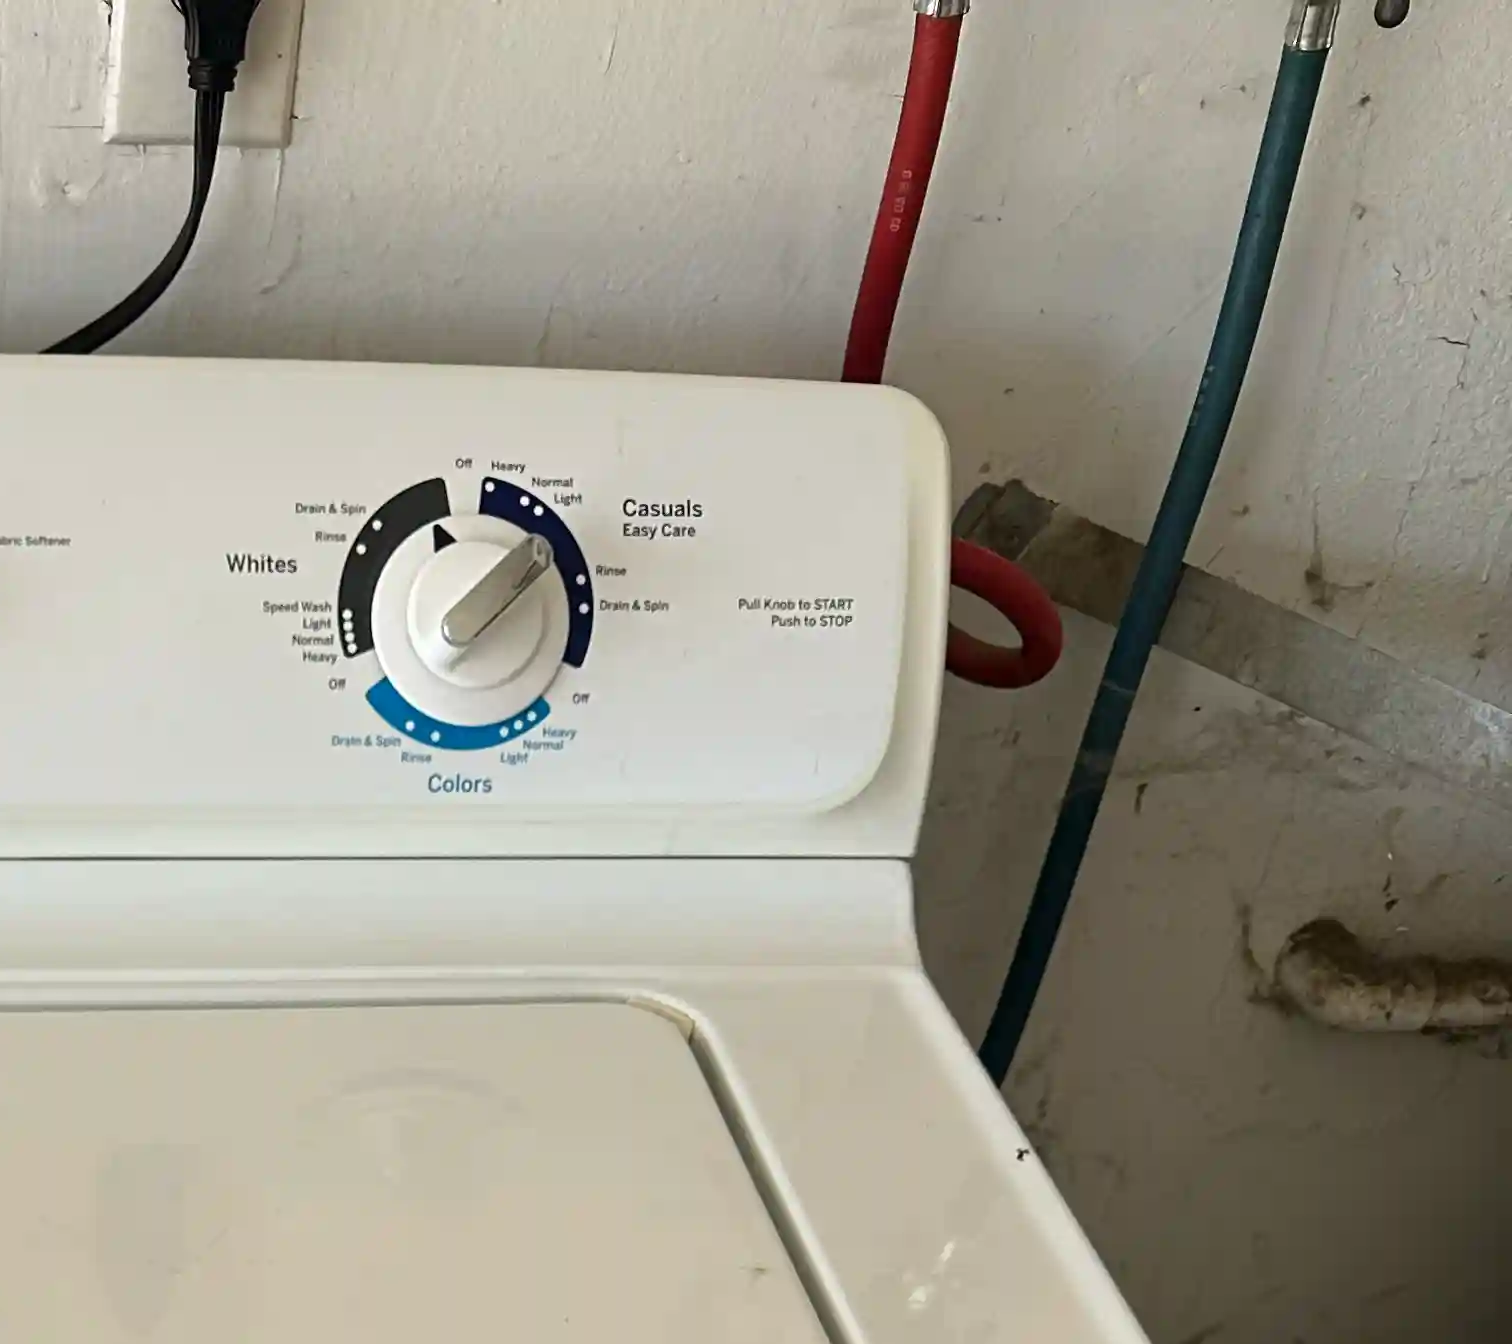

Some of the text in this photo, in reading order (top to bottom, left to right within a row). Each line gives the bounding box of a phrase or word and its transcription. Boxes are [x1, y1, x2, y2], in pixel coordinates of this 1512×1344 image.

[456, 458, 472, 469] Off
[491, 461, 525, 474] Heavy
[532, 477, 573, 487] Normal
[553, 494, 582, 506] Light
[296, 503, 325, 514] Drain
[340, 503, 366, 516] Spin
[623, 500, 702, 517] Casuals
[315, 531, 346, 542] Rinse
[622, 523, 696, 540] Easy Care
[25, 536, 71, 546] Softener
[227, 554, 297, 573] Whites
[596, 565, 626, 576] Rinse
[263, 602, 331, 615] Speed Wash
[600, 600, 628, 611] Drain
[644, 600, 669, 613] Spin
[739, 598, 853, 610] Pull Knob to START
[303, 618, 331, 631] Light
[772, 615, 852, 627] Push to STOP
[292, 634, 334, 645] Normal
[303, 652, 337, 665] Heavy
[329, 678, 346, 690] Off
[573, 693, 590, 704] Off
[542, 728, 576, 741] Heavy
[332, 735, 361, 747] Drain
[376, 735, 401, 747] Spin
[523, 740, 564, 750] Normal
[401, 752, 432, 763] Rinse
[500, 752, 529, 765] Light
[428, 773, 492, 793] Colors
